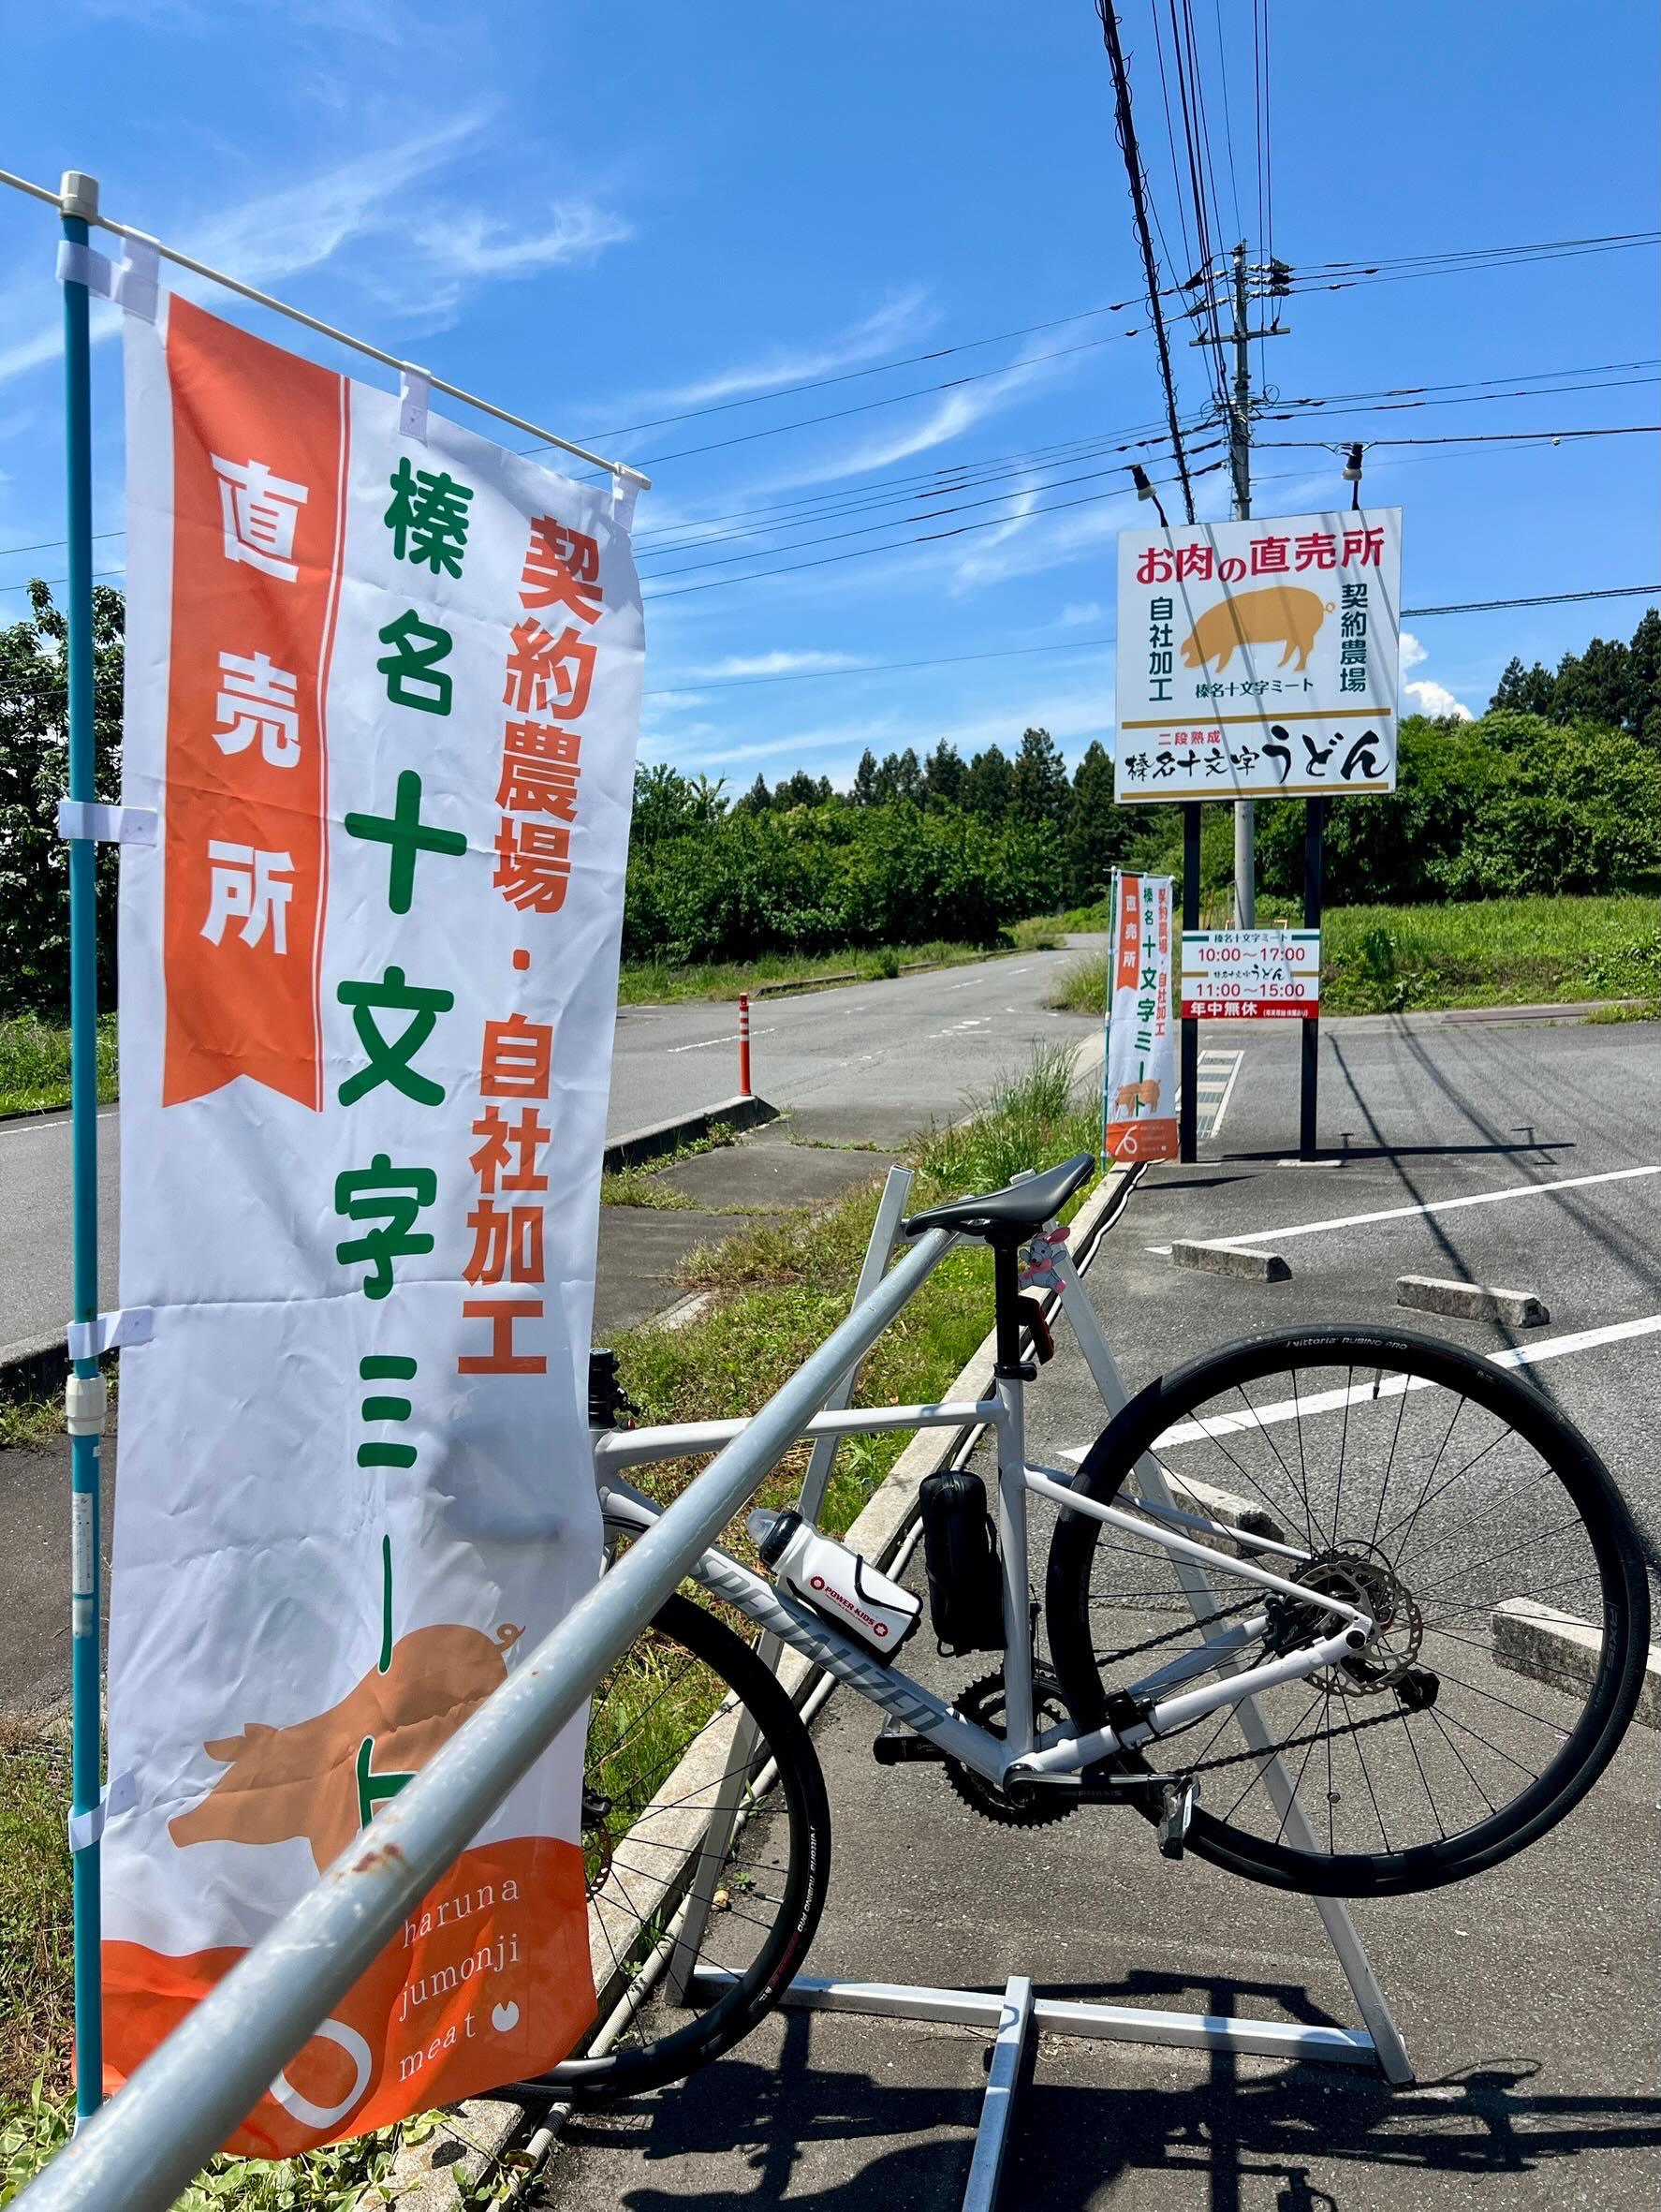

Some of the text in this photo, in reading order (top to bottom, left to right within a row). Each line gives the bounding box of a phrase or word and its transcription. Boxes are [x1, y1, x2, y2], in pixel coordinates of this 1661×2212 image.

[1136, 527, 1386, 585] お肉の直売所
[1149, 597, 1173, 701] 自社加工
[1340, 583, 1368, 693] 契約農場
[200, 452, 310, 955] 直売所
[1195, 678, 1314, 699] 榛名十文字ミート
[1158, 730, 1221, 745] 二段熟成
[457, 513, 603, 1376] 契約農場・自社加工
[1190, 1001, 1258, 1017] 年中無休
[824, 1585, 855, 1611] POWER
[689, 1554, 945, 1733] SPECIALIZED
[403, 1879, 521, 1949] haruna
[399, 1932, 520, 2023] jumonji
[399, 2012, 476, 2083] meat
